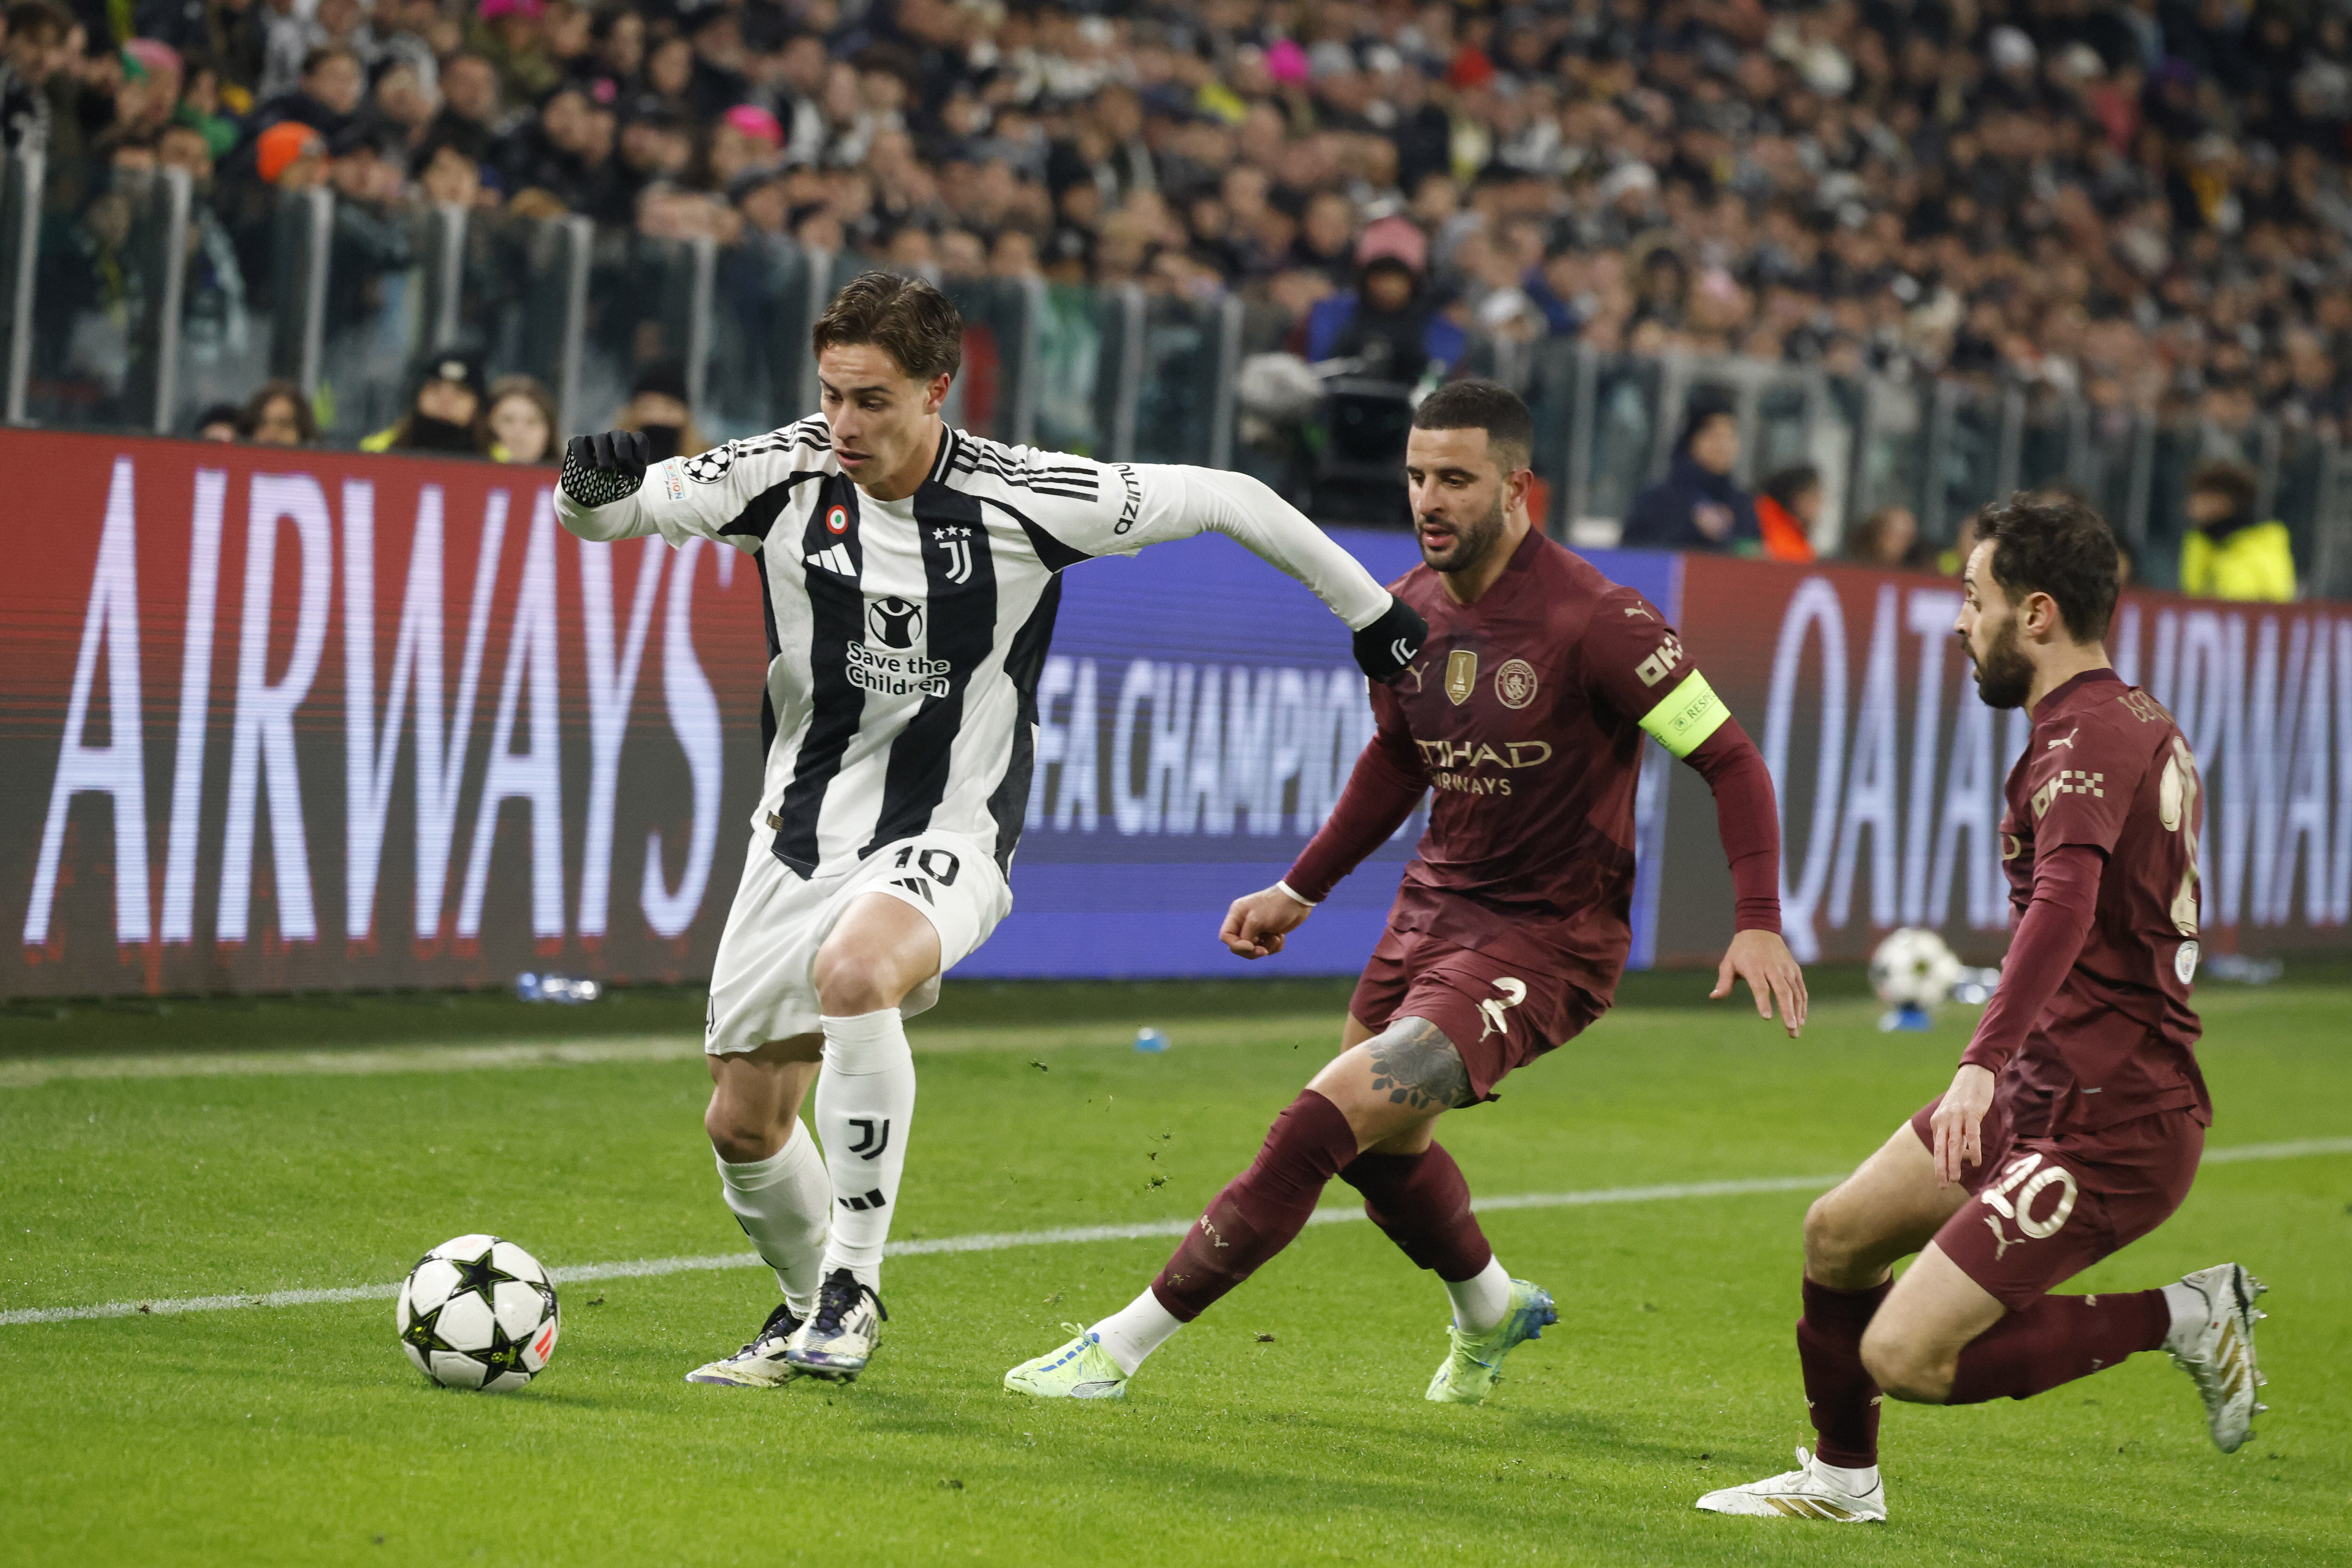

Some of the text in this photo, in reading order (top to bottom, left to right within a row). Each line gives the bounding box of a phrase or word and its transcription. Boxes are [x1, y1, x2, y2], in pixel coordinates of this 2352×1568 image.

[1112, 464, 1141, 535] azimu
[850, 643, 947, 674] Save the
[850, 666, 946, 695] Children
[24, 454, 734, 945] AIRWAYS
[1414, 739, 1552, 768] TIHAD
[895, 845, 960, 887] 10
[1482, 976, 1527, 1034] 2
[1981, 1153, 2078, 1239] 20
